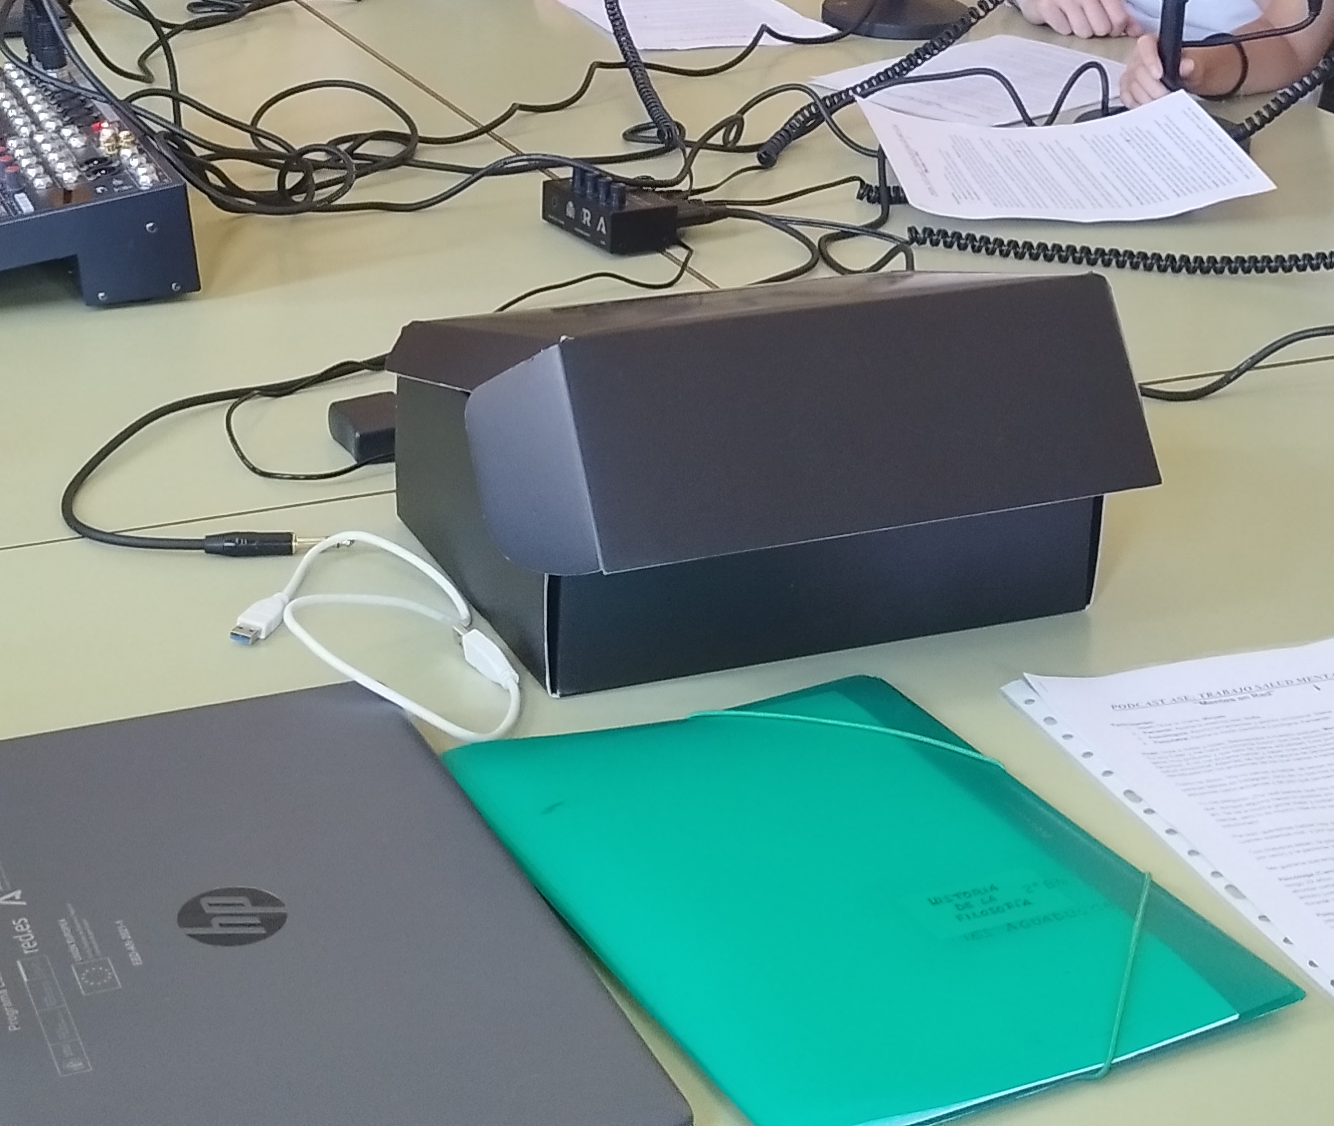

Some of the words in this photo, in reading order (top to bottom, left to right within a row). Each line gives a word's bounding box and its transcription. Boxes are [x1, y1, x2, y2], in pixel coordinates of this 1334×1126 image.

[1111, 697, 1165, 711] PODCAST
[1199, 684, 1254, 700] TRABAJO
[1255, 678, 1294, 692] SALUD
[183, 894, 288, 935] hp
[980, 894, 998, 905] LA
[12, 917, 40, 955] red.es
